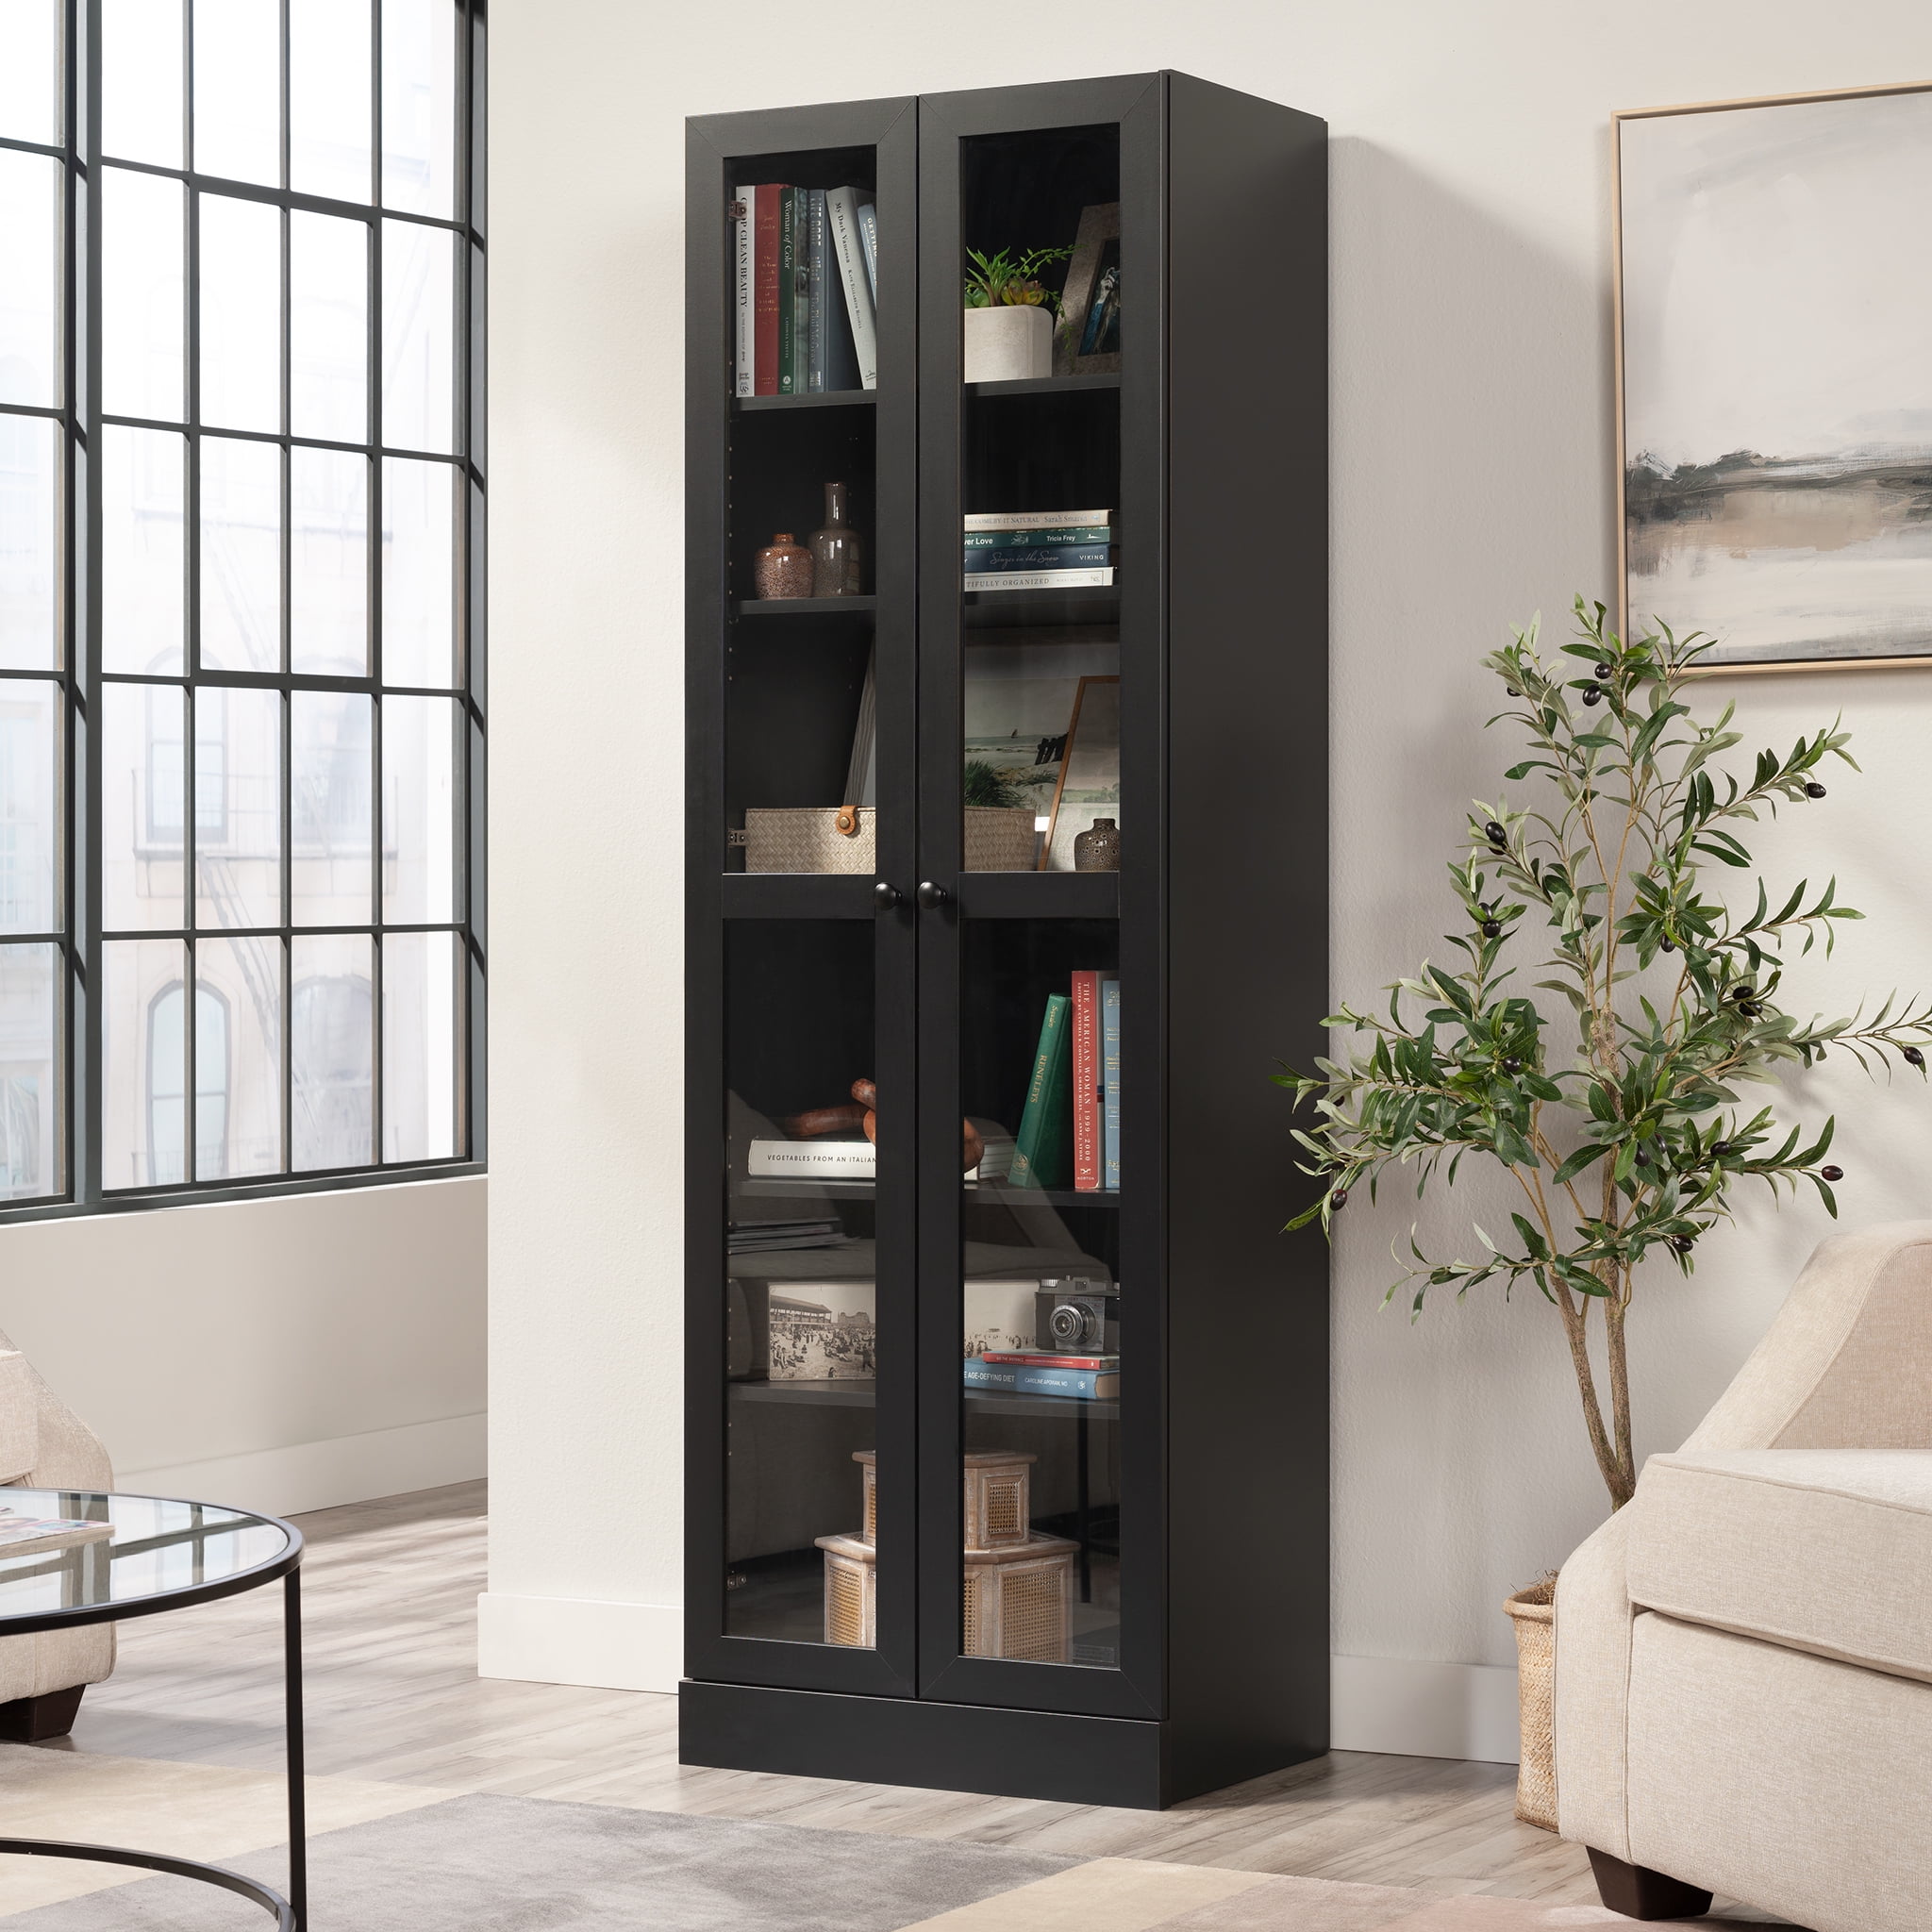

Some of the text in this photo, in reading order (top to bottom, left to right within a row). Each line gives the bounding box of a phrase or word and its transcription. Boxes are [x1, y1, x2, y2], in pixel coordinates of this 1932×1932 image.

[784, 234, 792, 244] of
[835, 202, 850, 263] My Dark Vanessa
[1025, 550, 1037, 561] the
[1037, 550, 1059, 563] Snow
[1030, 1081, 1041, 1103] LEYS
[967, 1372, 1003, 1382] AGE-DEFYING
